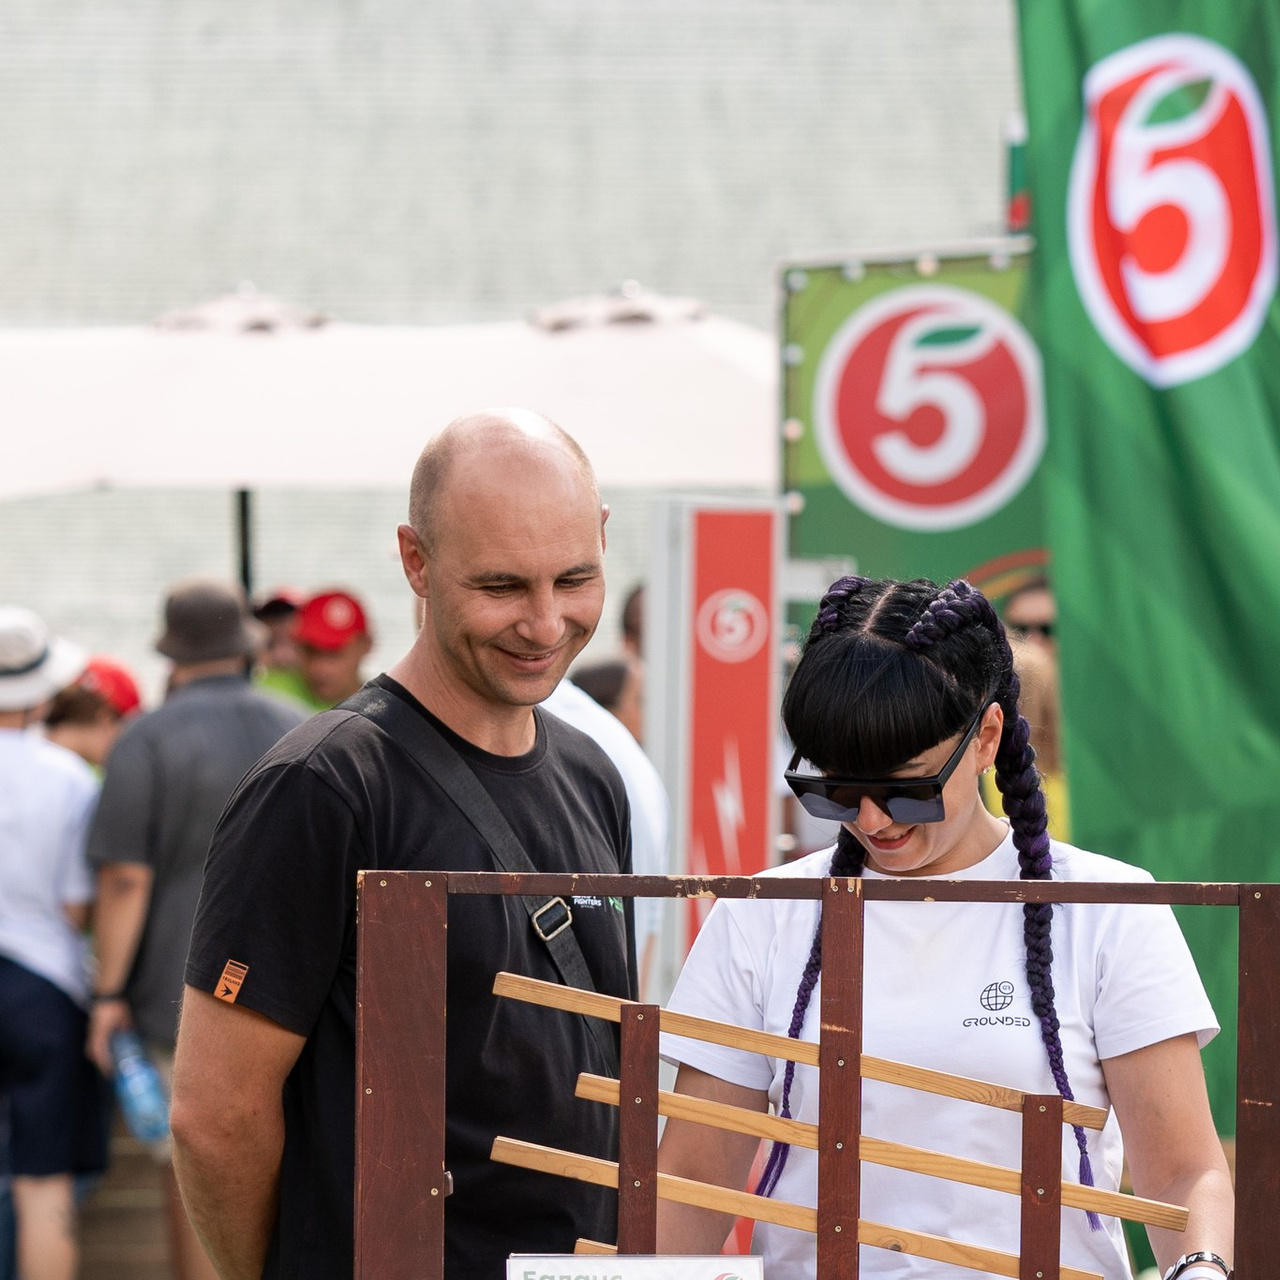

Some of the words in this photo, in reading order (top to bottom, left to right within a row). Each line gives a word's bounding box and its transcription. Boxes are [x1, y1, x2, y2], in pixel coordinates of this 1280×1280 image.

[1105, 75, 1233, 324] 5
[872, 317, 998, 486] 5
[962, 1016, 1031, 1028] GROUNDED
